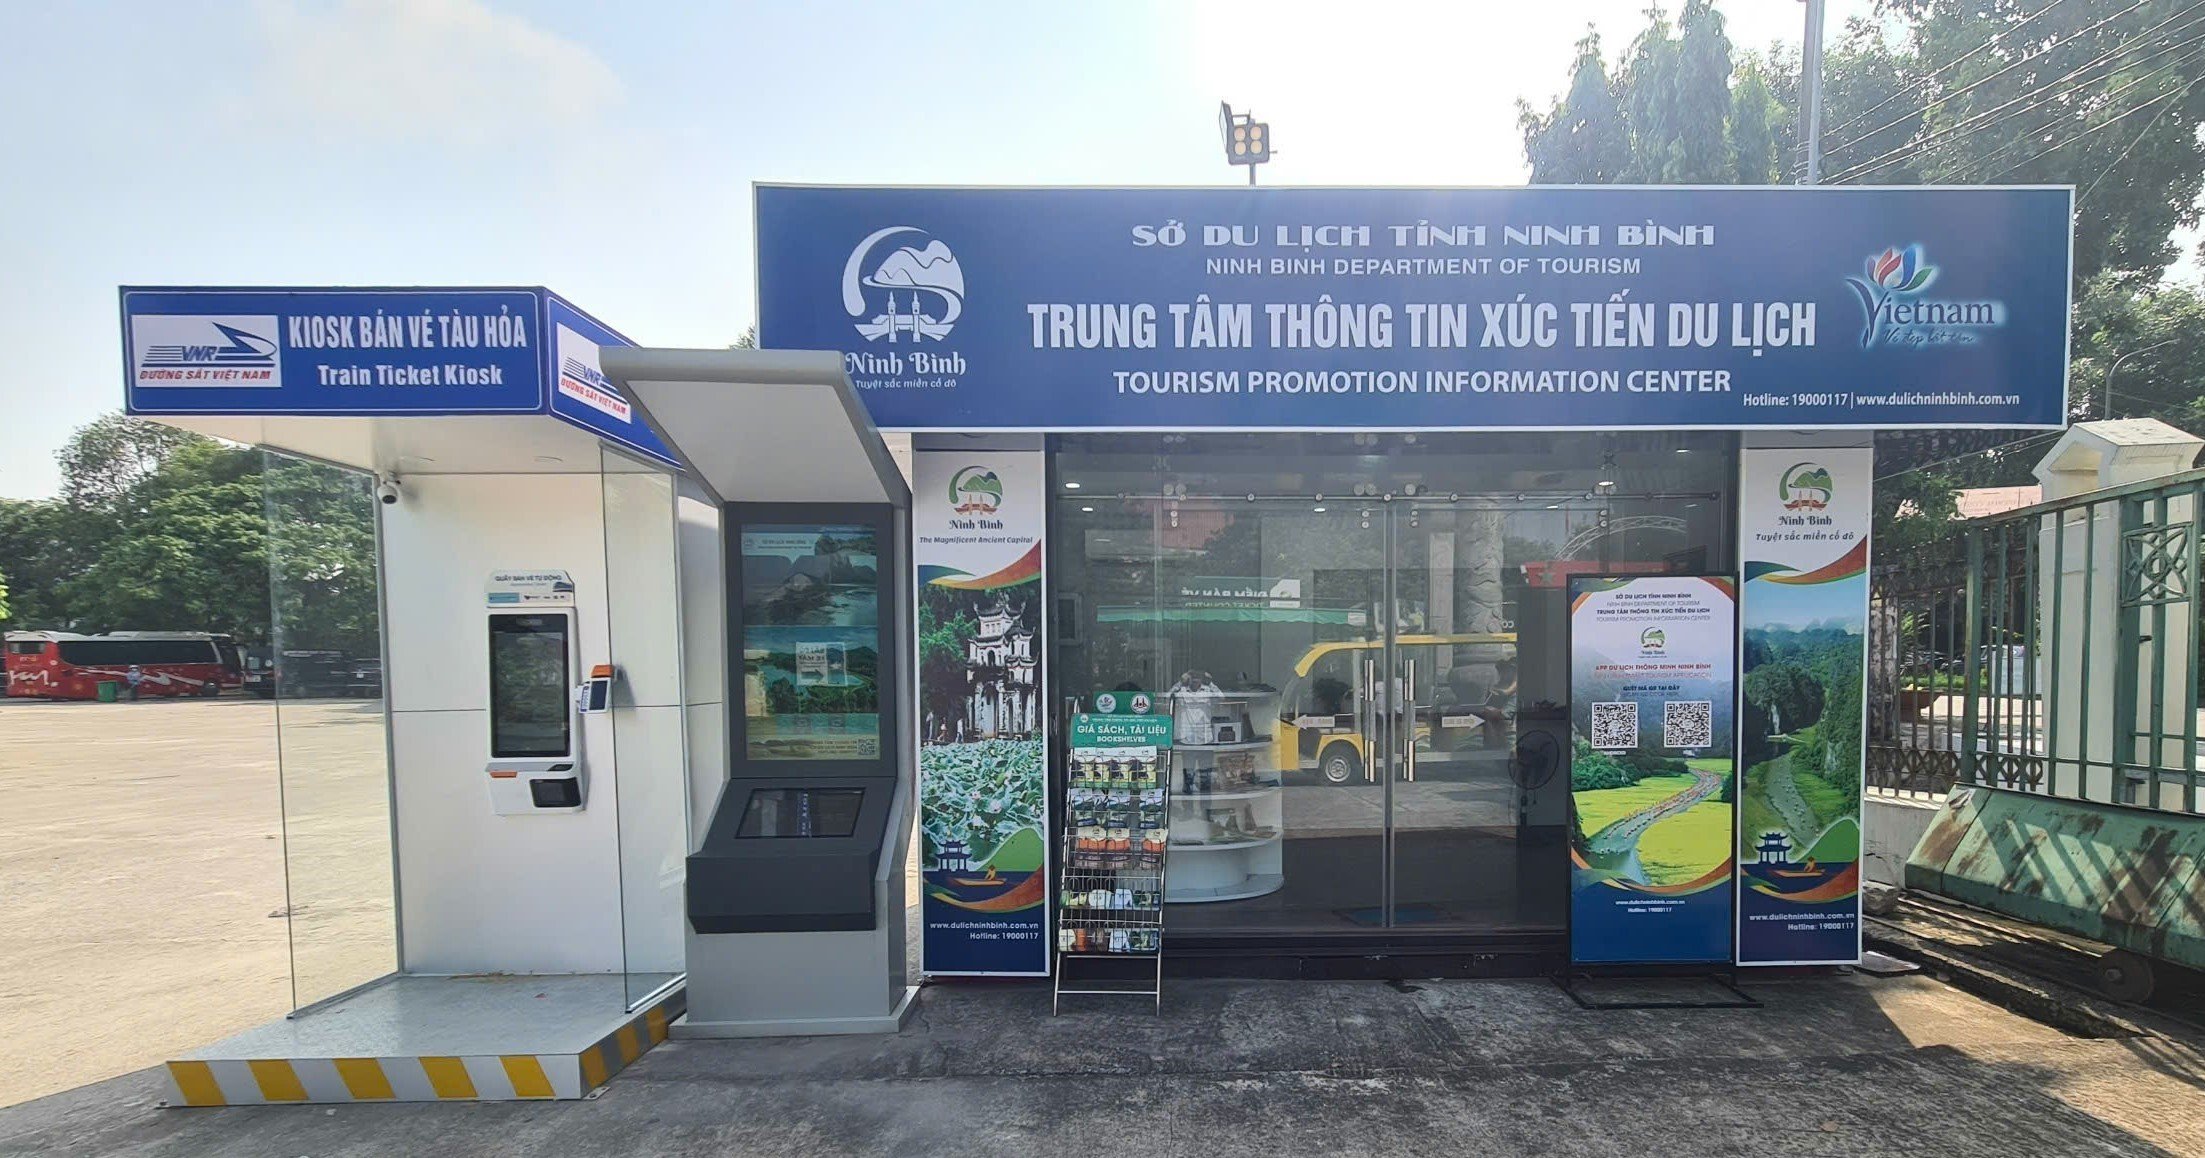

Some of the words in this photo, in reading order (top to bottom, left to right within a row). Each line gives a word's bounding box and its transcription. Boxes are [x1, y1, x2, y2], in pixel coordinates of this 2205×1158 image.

[1131, 219, 1187, 247] SỞ
[1203, 225, 1260, 246] DU
[1276, 225, 1371, 253] LỊCH
[1387, 219, 1486, 246] TỈNH
[1504, 225, 1600, 246] NINH
[1617, 219, 1715, 246] BÌNH
[1206, 258, 1262, 275] NINH
[1270, 258, 1326, 275] BINH
[1333, 258, 1492, 274] DEPARTMENT
[1499, 257, 1530, 275] OF
[1537, 257, 1641, 274] TOURISM
[1844, 278, 1995, 349] Vietnam
[288, 316, 355, 348] KIOSK
[359, 309, 404, 348] BÁN
[408, 308, 434, 348] VÉ
[438, 309, 478, 348] TÀU
[484, 304, 527, 348] HỎA
[1027, 303, 1157, 349] TRUNG
[1168, 294, 1253, 349] TÂM
[1265, 294, 1393, 349] THÔNG
[1405, 303, 1467, 348] TIN
[1480, 293, 1558, 348] XÚC
[1571, 288, 1655, 348] TIẾN
[1668, 302, 1719, 348] DU
[1731, 302, 1816, 357] LỊCH
[182, 346, 217, 361] VNR
[845, 351, 903, 376] Ninh
[242, 371, 271, 379] NAM
[317, 365, 371, 385] Train
[376, 365, 440, 385] Ticket
[445, 364, 502, 385] Kiosk
[1113, 371, 1239, 393] TOURISM
[1247, 370, 1418, 393] PROMOTION
[1426, 370, 1619, 393] INFORMATION
[1626, 370, 1731, 393] CENTER
[1743, 393, 1789, 406] Hotline:
[1792, 393, 1848, 406] 19000117
[1856, 392, 2020, 406] www.dulichninhbinh.com.vn
[949, 520, 975, 530] Ninh
[1778, 516, 1804, 526] Ninh
[934, 536, 976, 545] Magnificent
[1007, 536, 1032, 545] Capital
[1077, 724, 1095, 734] GIÁ
[1098, 724, 1127, 735] SÁCH,
[1130, 724, 1144, 734] TÀI
[1147, 725, 1166, 736] LIỆU
[1749, 912, 1855, 921] www.dulichninhbinh.com.vn
[1820, 922, 1854, 930] 19000117
[1002, 932, 1038, 940] 19000117
